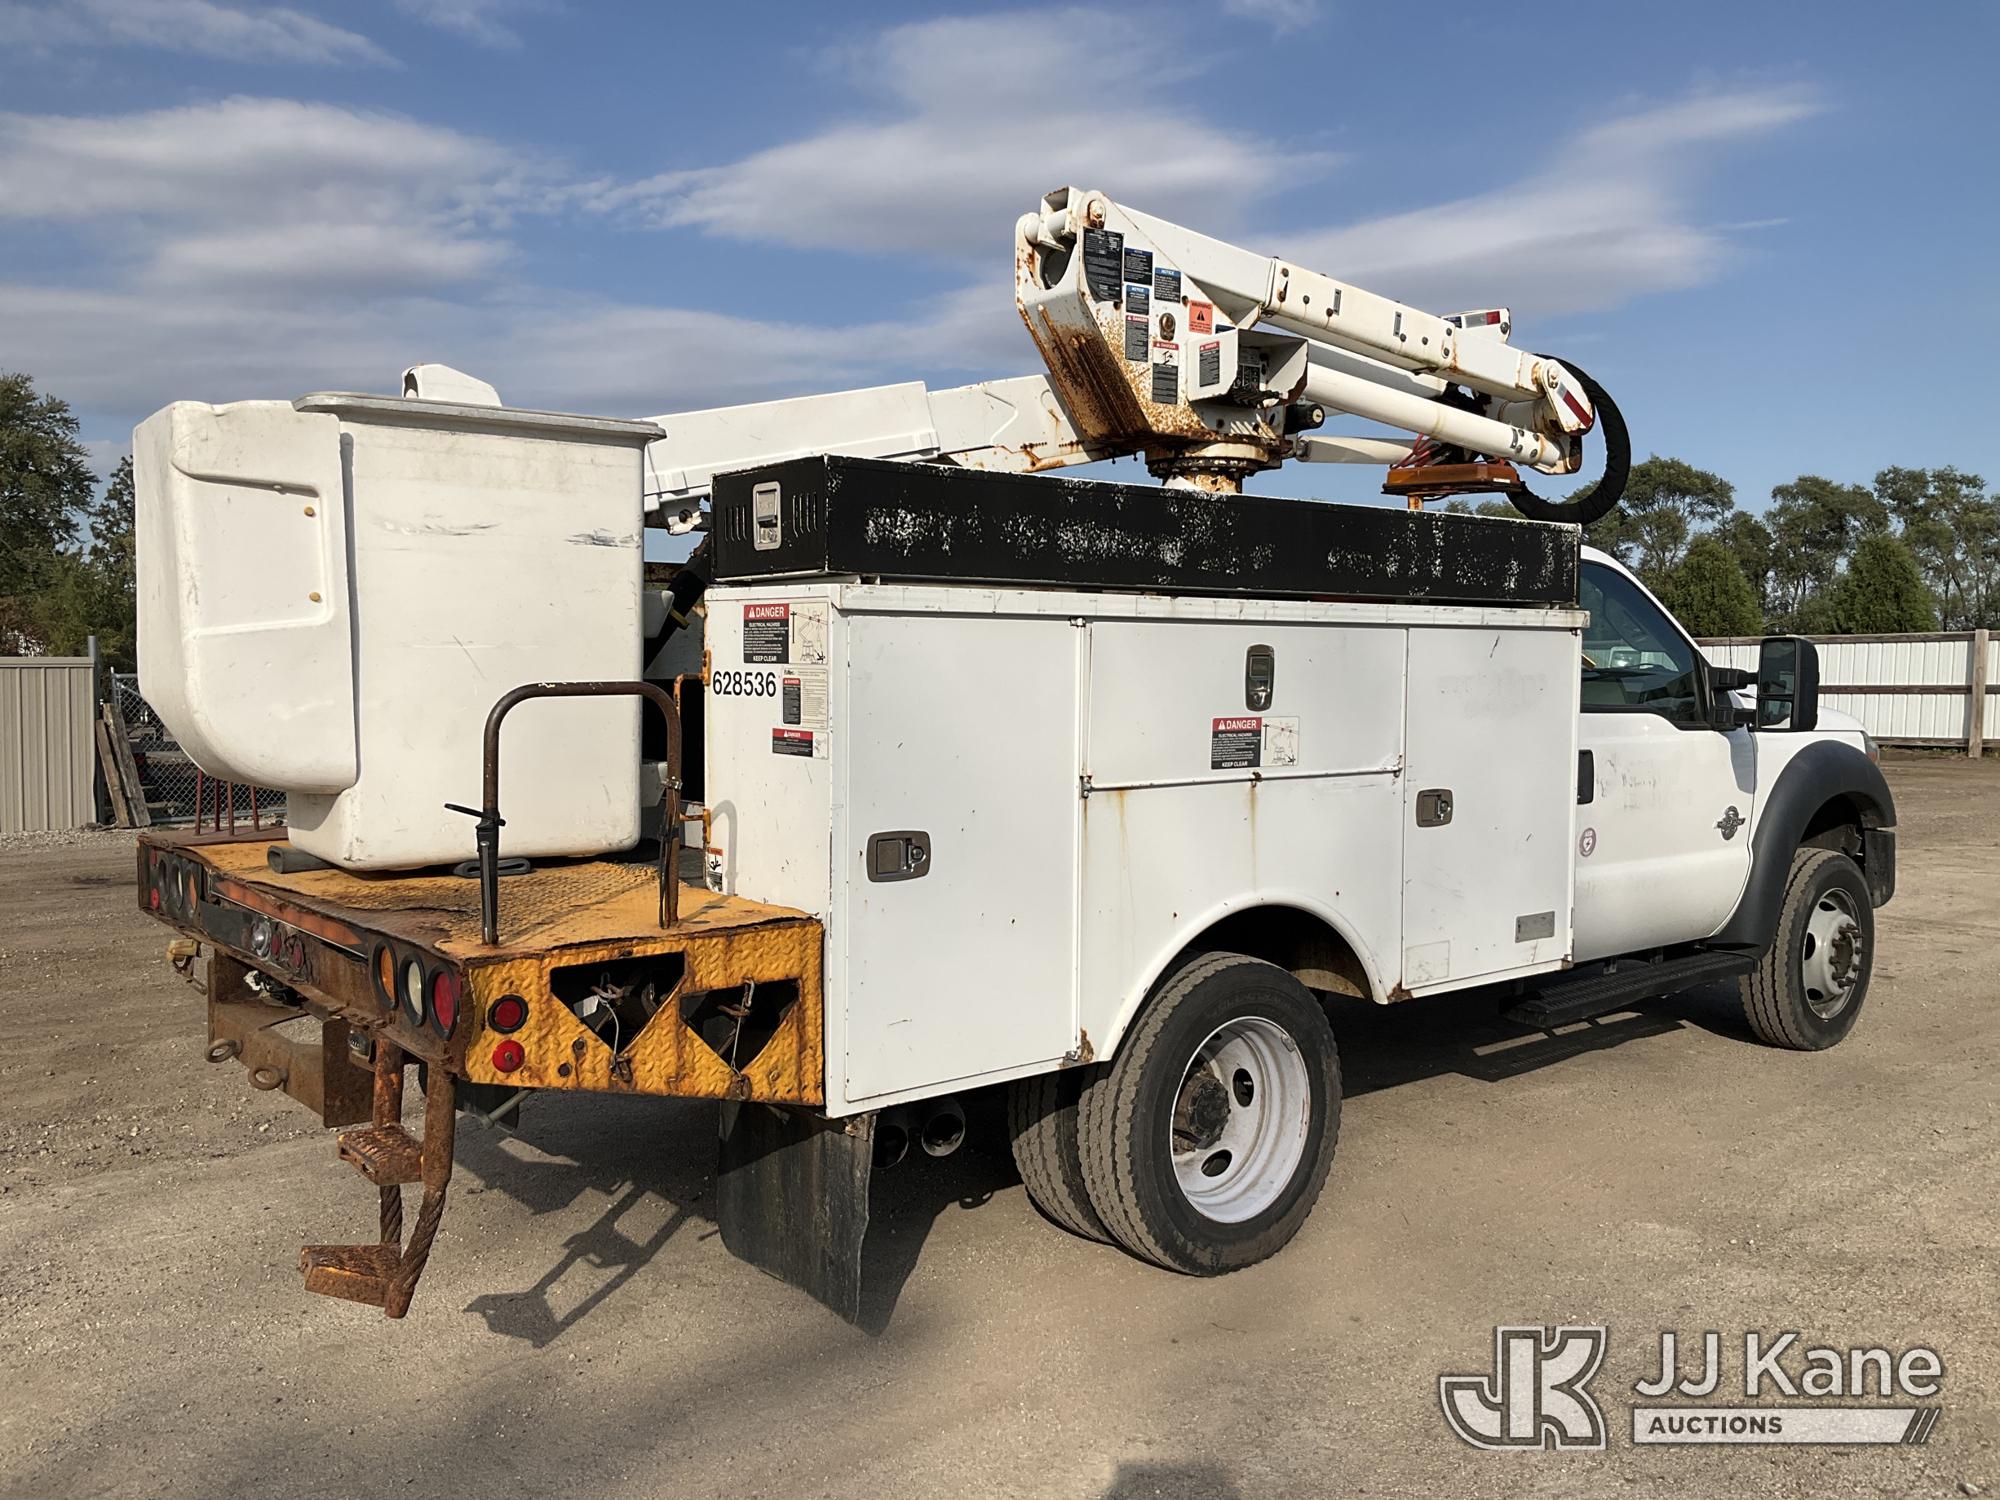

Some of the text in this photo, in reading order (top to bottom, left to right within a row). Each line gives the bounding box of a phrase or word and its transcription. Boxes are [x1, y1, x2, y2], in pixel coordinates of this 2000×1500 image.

[755, 607, 784, 617] DANGER
[713, 671, 776, 697] 628536
[1226, 720, 1256, 729] DANGER
